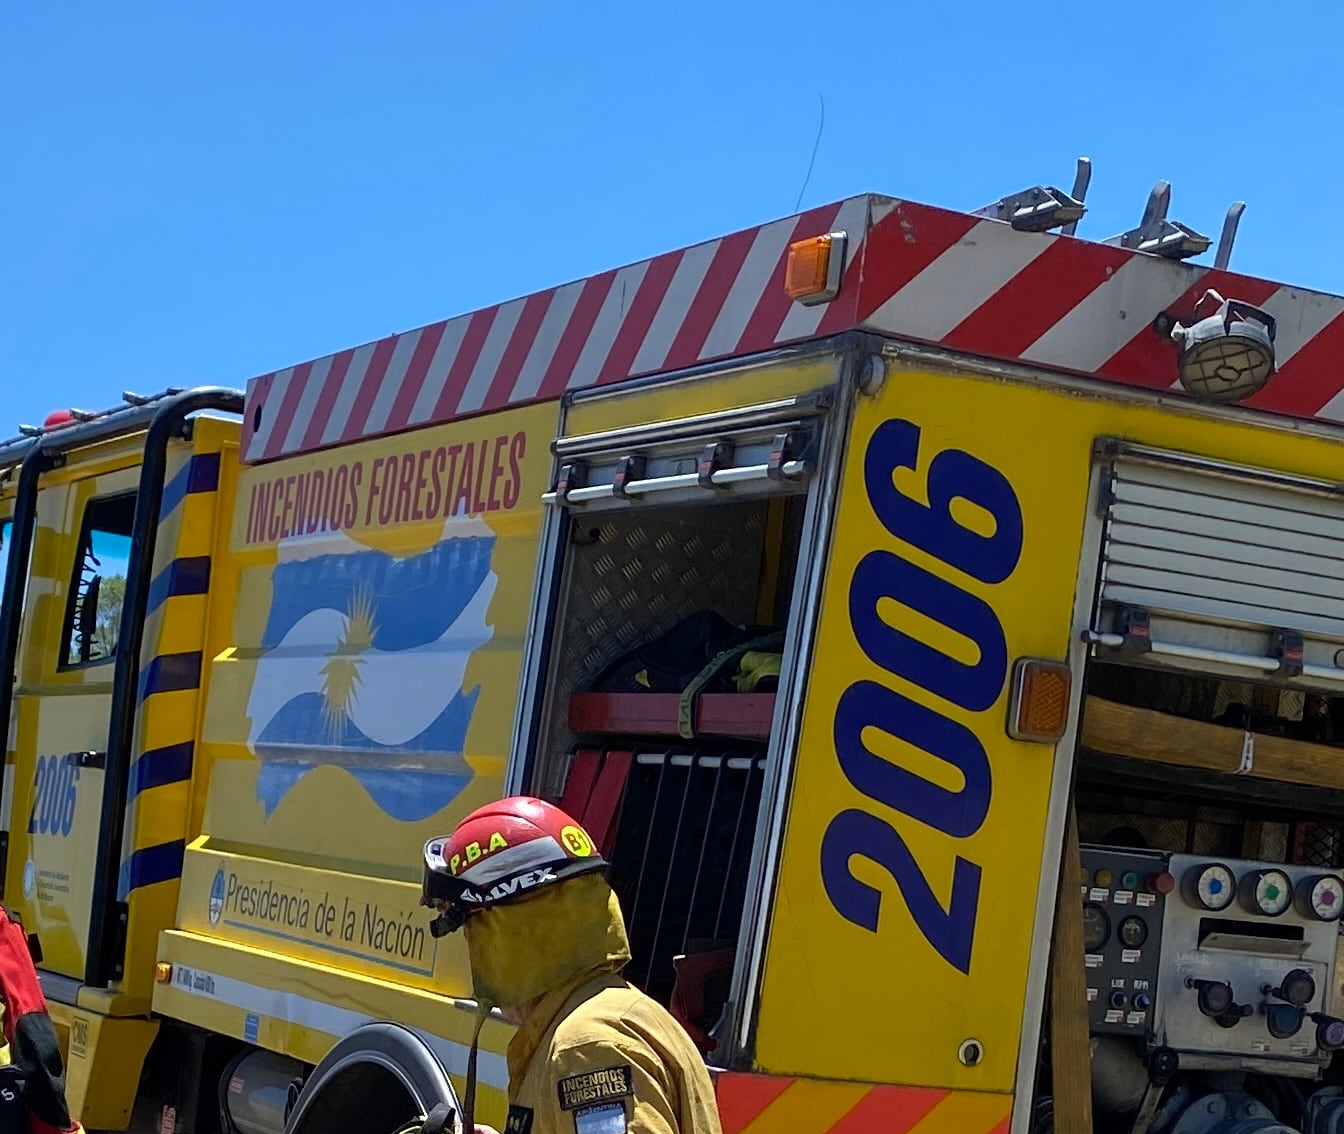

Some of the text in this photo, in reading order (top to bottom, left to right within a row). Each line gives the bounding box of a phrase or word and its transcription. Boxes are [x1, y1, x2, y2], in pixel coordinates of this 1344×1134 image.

[246, 431, 526, 544] INCENDIOS FORESTALES
[820, 418, 1024, 975] 2006
[27, 755, 80, 838] 2006
[225, 873, 425, 961] Presidencia de la Nación
[1, 1088, 15, 1101] 5
[562, 1069, 625, 1092] INCENDIOS
[564, 1080, 628, 1105] FORESTALES
